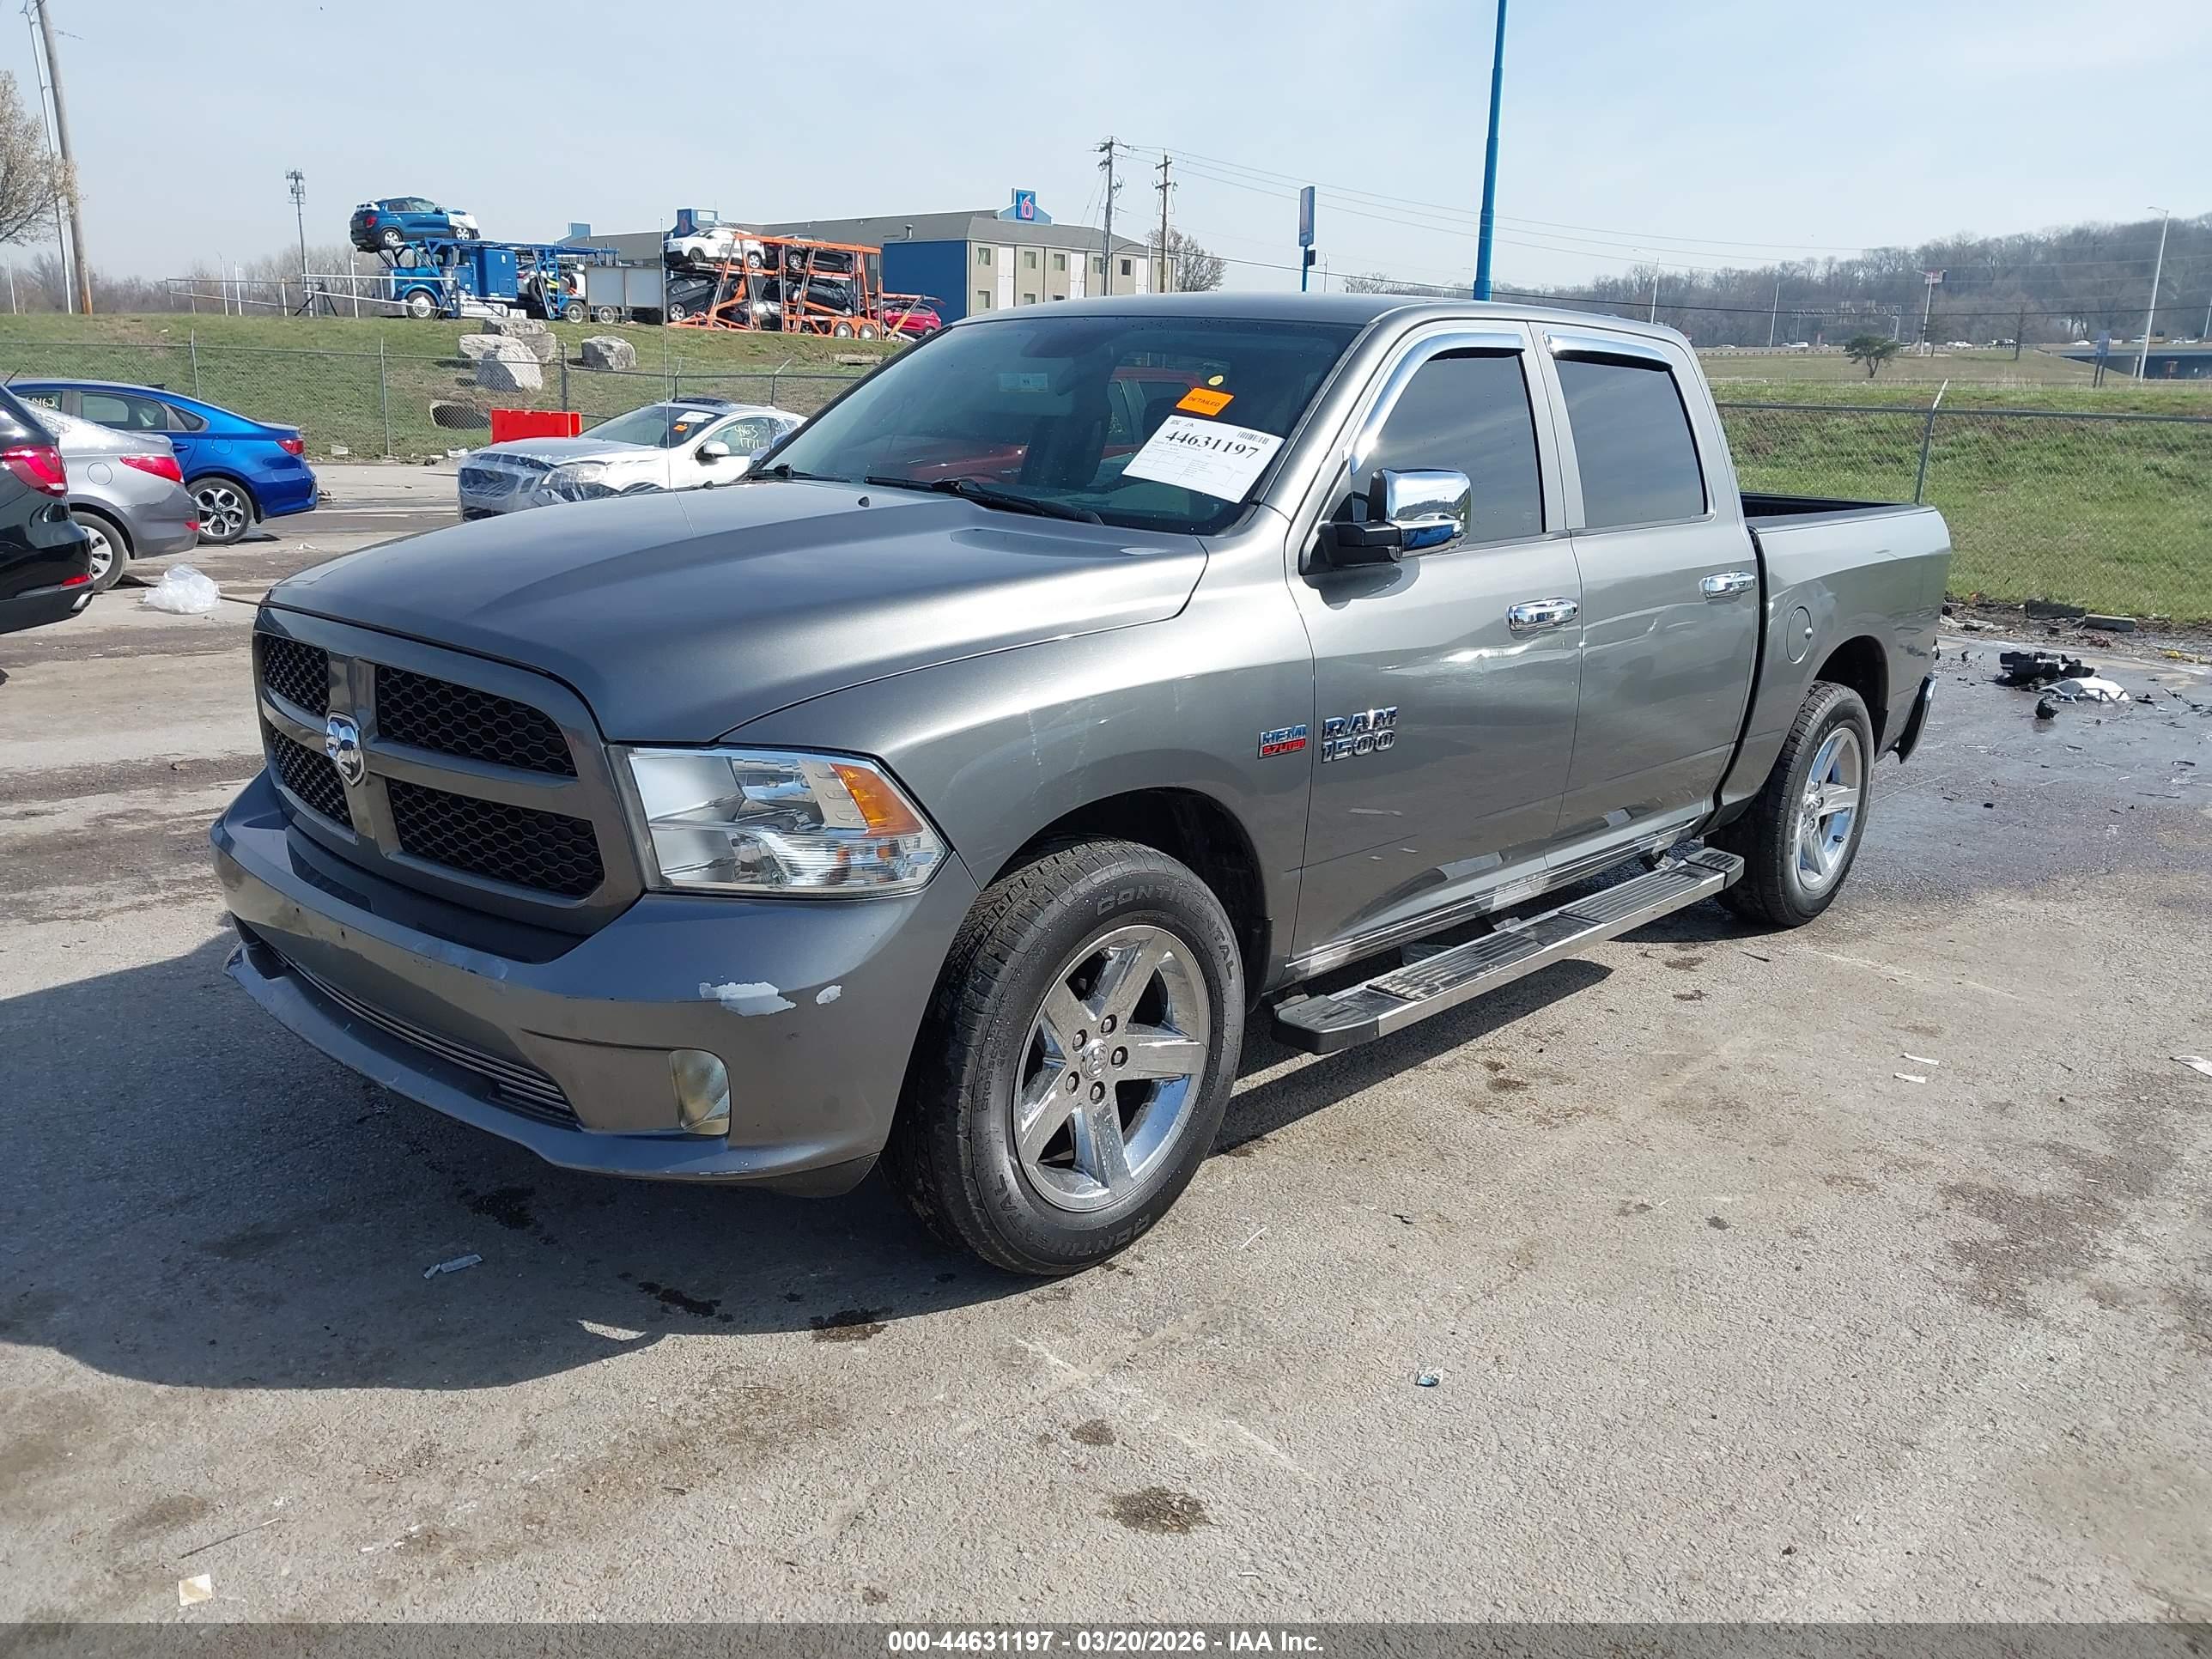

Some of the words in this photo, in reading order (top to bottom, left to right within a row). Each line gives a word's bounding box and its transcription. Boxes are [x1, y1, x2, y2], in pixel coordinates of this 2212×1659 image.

[1021, 195, 1034, 219] 6
[1188, 396, 1221, 407] DETAILED
[734, 424, 759, 438] 4463
[1165, 430, 1260, 459] 44631197
[1260, 725, 1306, 744] HEMI
[1323, 707, 1399, 739] RAM
[1322, 729, 1395, 763] 1500
[1097, 885, 1235, 981] CONTINENTAL
